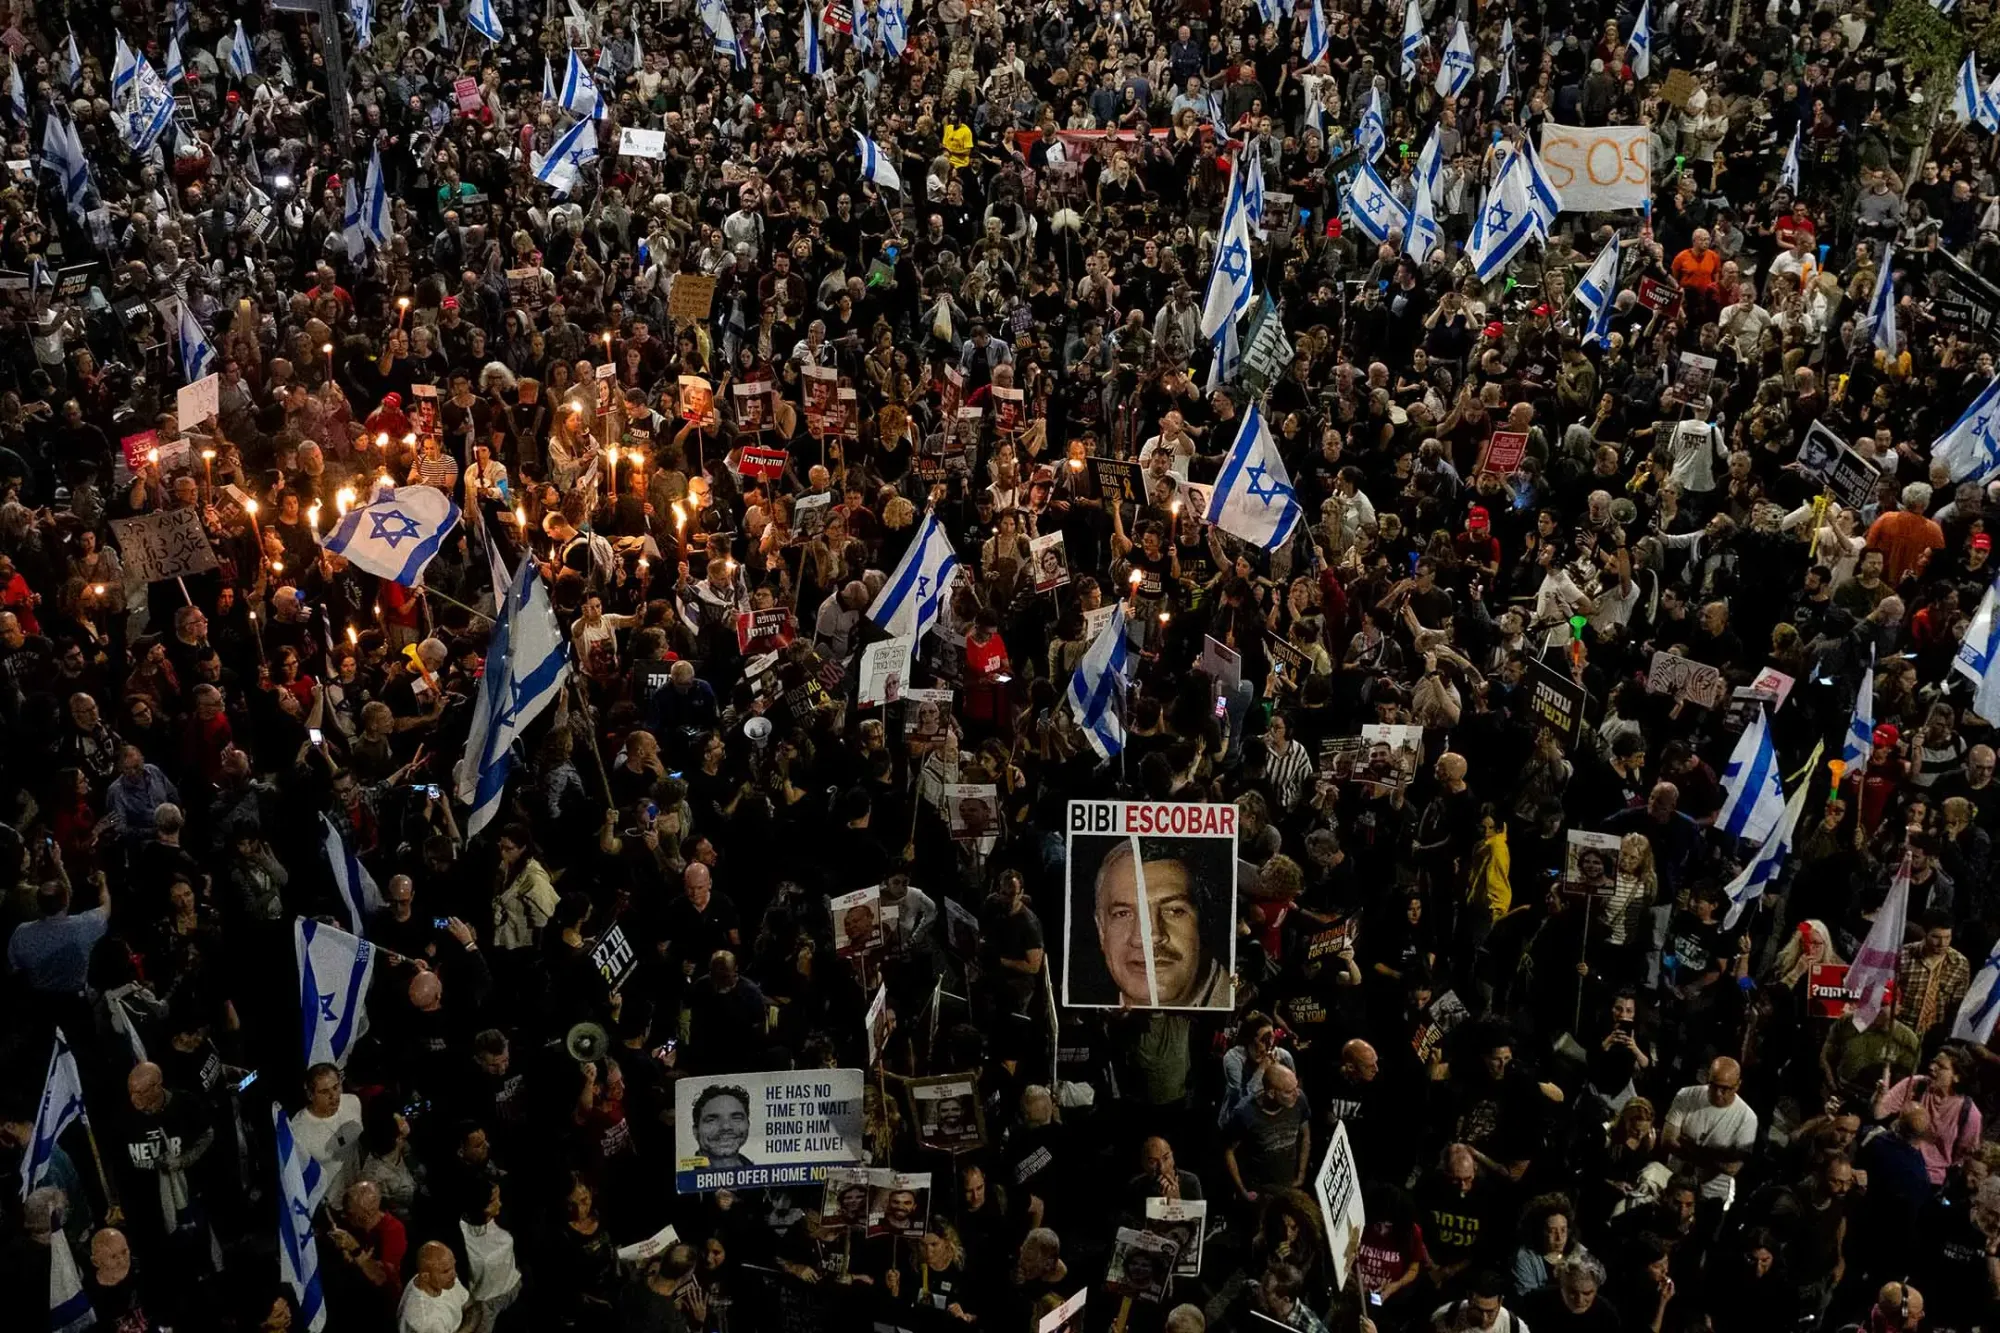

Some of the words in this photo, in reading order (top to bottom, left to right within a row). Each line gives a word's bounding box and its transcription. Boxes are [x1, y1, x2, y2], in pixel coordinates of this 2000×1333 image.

[1544, 139, 1648, 189] SOS
[1097, 461, 1131, 478] HOSTAGE
[1100, 473, 1120, 487] DEAL
[1102, 485, 1121, 498] NOW
[1274, 640, 1303, 669] HOSTAGE
[818, 658, 846, 692] SOS
[786, 678, 822, 705] HOSTAG
[1536, 681, 1573, 712] עסקה
[790, 698, 817, 719] DEAL
[1532, 696, 1572, 732] עכשיו!
[1071, 803, 1117, 832] BIBI
[1125, 804, 1235, 835] ESCOBAR
[606, 925, 625, 949] עד
[592, 942, 609, 970] לא
[600, 938, 634, 985] נדע?
[1308, 947, 1323, 960] FOR
[1307, 1008, 1327, 1021] YOU!
[766, 1086, 783, 1101] HE
[785, 1085, 811, 1100] HAS
[814, 1083, 832, 1098] NO
[766, 1103, 796, 1118] TIME
[799, 1102, 815, 1117] TO
[818, 1101, 852, 1116] WAIT.
[766, 1120, 803, 1136] BRING
[806, 1119, 831, 1135] HIM
[128, 1135, 182, 1161] NEVR
[766, 1138, 802, 1154] HOME
[804, 1136, 844, 1153] ALIVE!
[696, 1170, 736, 1190] BRING
[737, 1168, 769, 1187] OFER
[770, 1166, 808, 1184] HOME
[1328, 1151, 1348, 1205] PEOPLE
[1439, 1229, 1477, 1248] עכש
